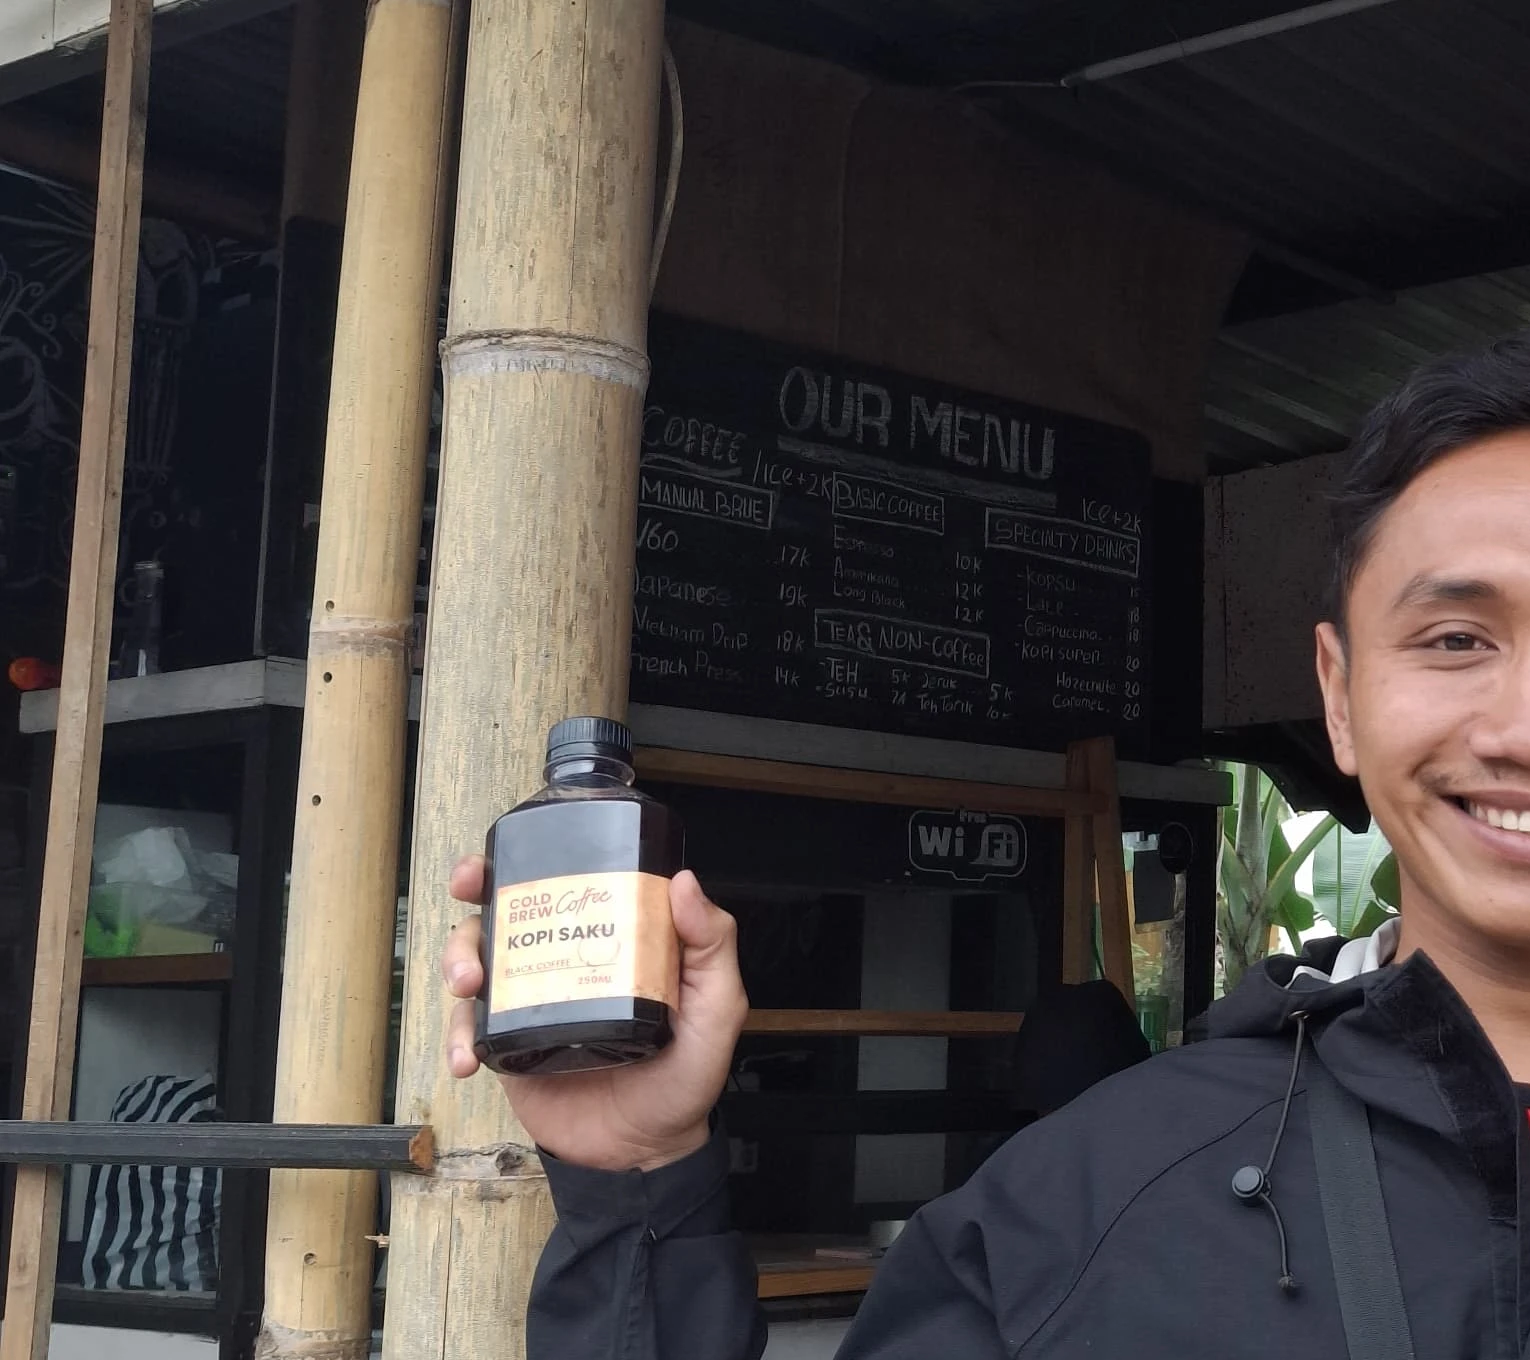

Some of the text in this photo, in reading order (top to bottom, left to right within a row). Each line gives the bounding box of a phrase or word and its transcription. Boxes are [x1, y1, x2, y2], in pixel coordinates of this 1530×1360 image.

[779, 367, 1056, 479] OUR MENU
[641, 476, 711, 512] MANUAL
[836, 480, 941, 521] BASIC COFFEE
[1084, 533, 1136, 564] DRINKS
[508, 905, 554, 925] BREW
[510, 892, 552, 910] COLD
[507, 922, 615, 951] KOPI SAKU
